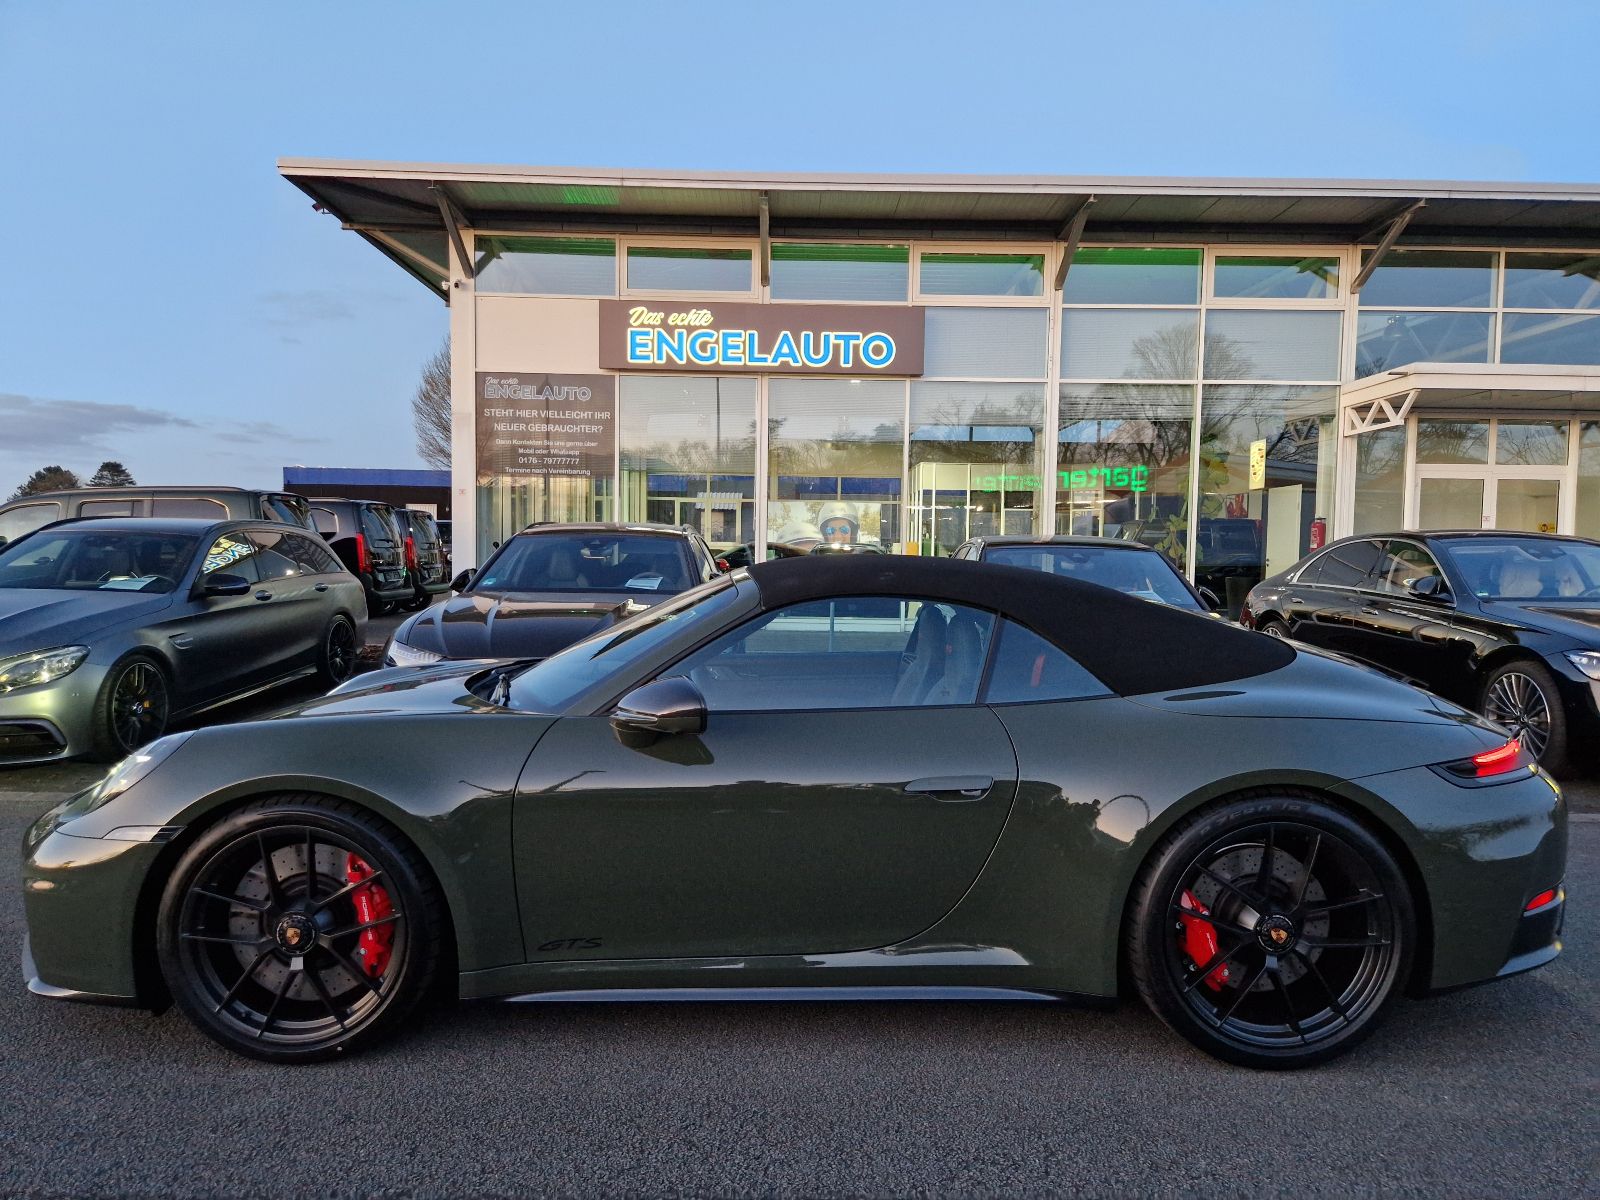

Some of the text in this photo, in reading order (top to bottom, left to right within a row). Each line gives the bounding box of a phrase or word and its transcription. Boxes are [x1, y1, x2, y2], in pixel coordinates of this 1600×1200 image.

[628, 306, 714, 327] Das echte
[627, 327, 897, 369] ENGELAUTO
[484, 385, 592, 401] ENGELAUTO
[484, 408, 611, 420] STEHT HIER VIELLEICHT IHR
[494, 422, 604, 433] NEUER GEBRAUCHTER?
[505, 466, 531, 474] Termine
[537, 937, 603, 952] GTS
